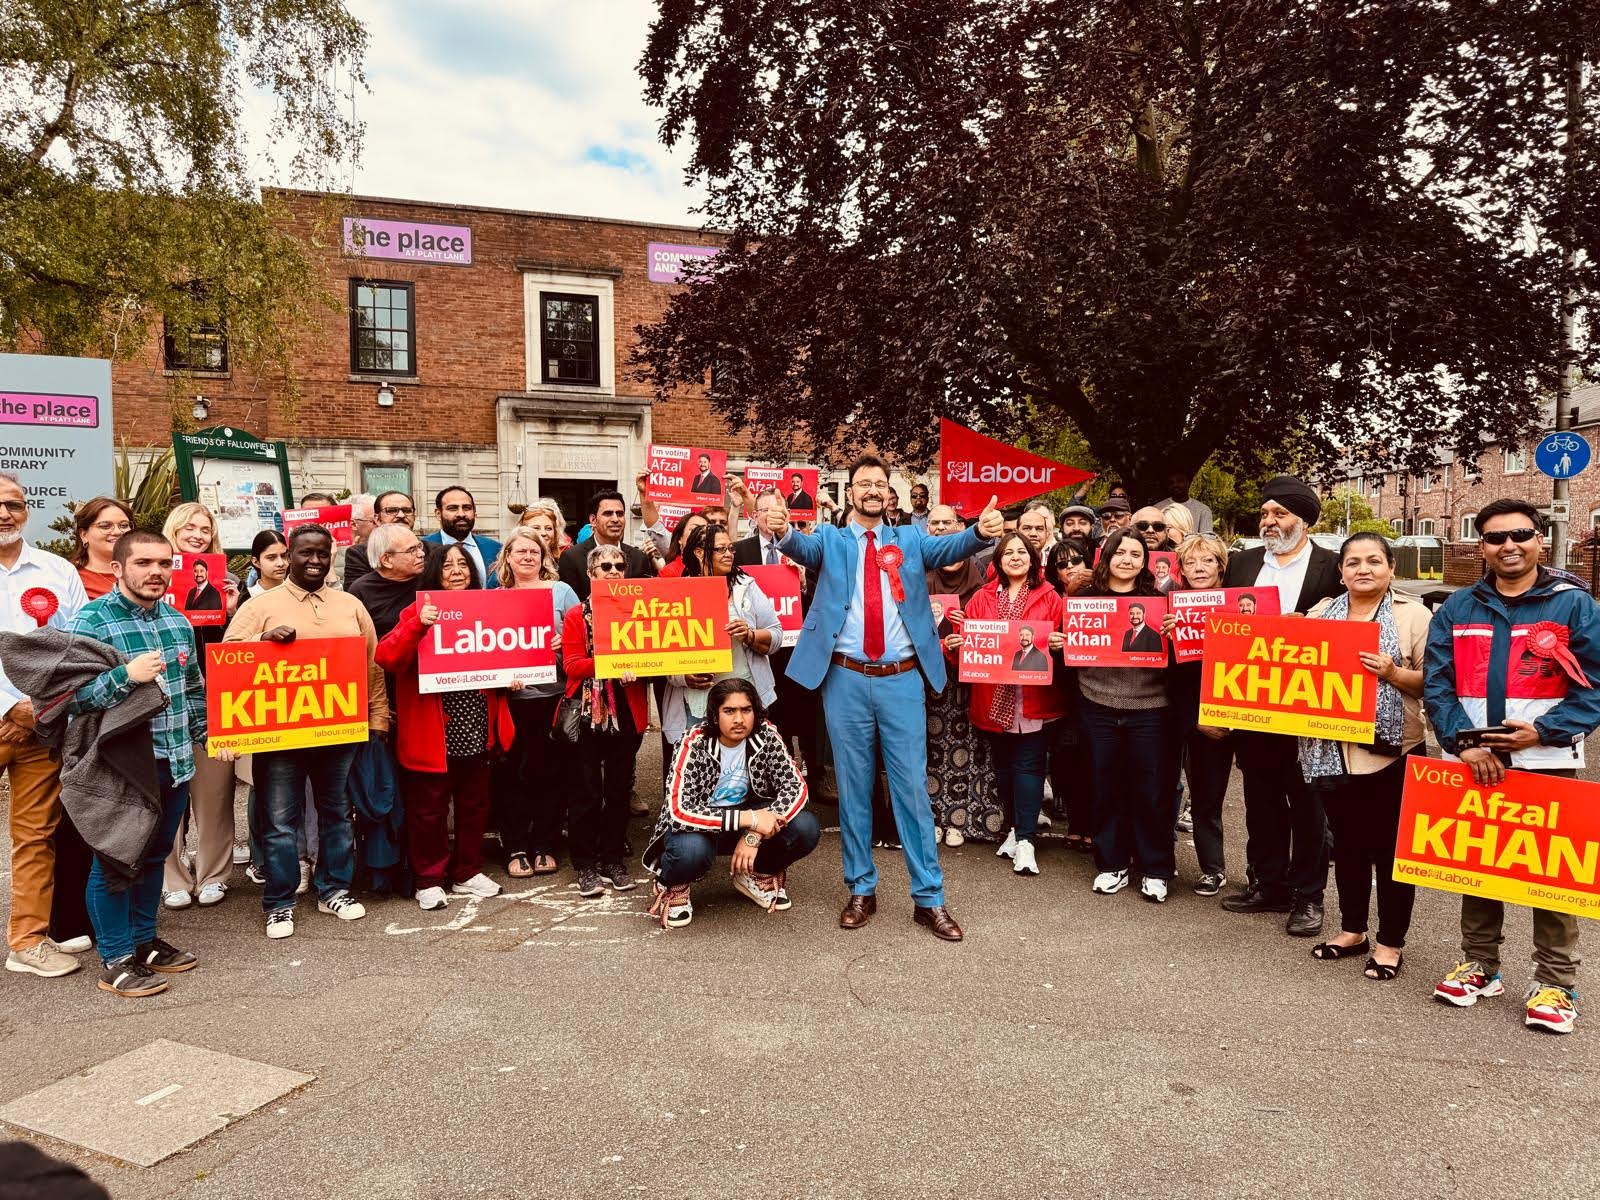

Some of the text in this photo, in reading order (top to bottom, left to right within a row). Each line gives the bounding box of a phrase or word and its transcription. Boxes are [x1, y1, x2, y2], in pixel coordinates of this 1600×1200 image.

[398, 229, 465, 252] place
[418, 251, 442, 259] PLATT
[444, 253, 464, 261] LANE
[654, 263, 677, 273] AND
[33, 401, 91, 418] place
[182, 435, 275, 451] FRIENDS OF FALLOWFIELD
[0, 447, 76, 458] OMMUNITY
[666, 449, 688, 458] voting
[0, 459, 48, 470] BRARY
[651, 458, 682, 472] Afzal
[649, 472, 684, 488] Khan
[760, 471, 782, 479] voting
[968, 461, 1056, 484] Labour
[22, 486, 67, 497] OURCE
[608, 583, 643, 596] Vote
[1068, 601, 1114, 611] I'm voting
[1174, 594, 1222, 604] I'm voting
[631, 596, 692, 619] Afzal
[965, 622, 1007, 633] I'm voting
[1067, 614, 1107, 629] Afzal
[1209, 618, 1251, 636] Vote
[433, 620, 552, 655] Labour
[610, 618, 715, 651] KHAN
[963, 634, 1000, 649] Afzal
[1067, 631, 1112, 647] Khan
[212, 650, 255, 665] Vote
[963, 651, 1003, 665] Khan
[1247, 636, 1329, 666] Afzal
[253, 657, 327, 685] Afzal
[513, 671, 553, 679] labour.org.uk
[1213, 661, 1364, 713] KHAN
[220, 682, 358, 729] KHAN
[314, 725, 368, 738] labour.org.uk
[1308, 719, 1372, 735] labour.org.uk
[1412, 763, 1464, 788] Vote
[1456, 789, 1560, 829] Afzal
[1411, 812, 1600, 885] KHAN
